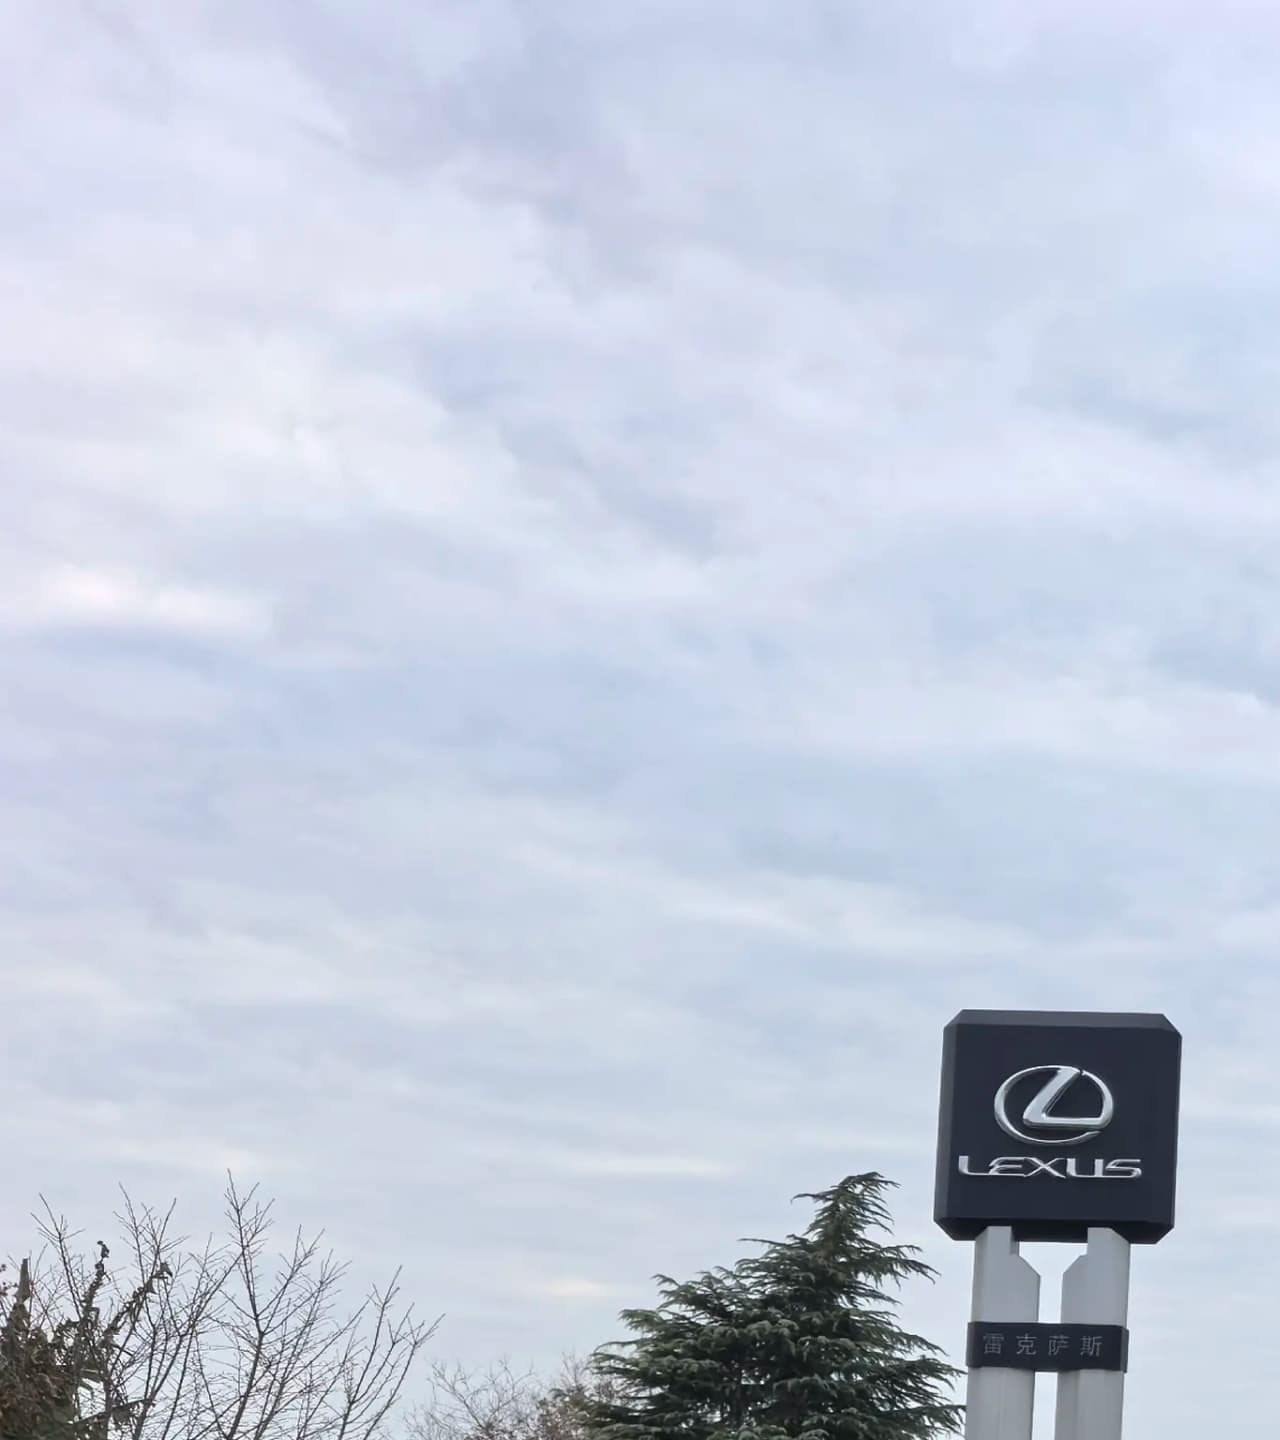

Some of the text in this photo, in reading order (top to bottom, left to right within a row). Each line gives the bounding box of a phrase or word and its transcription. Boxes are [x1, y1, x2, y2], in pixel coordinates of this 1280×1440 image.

[958, 1155, 1142, 1179] LEXUS
[982, 1332, 1104, 1357] 雷克萨斯
